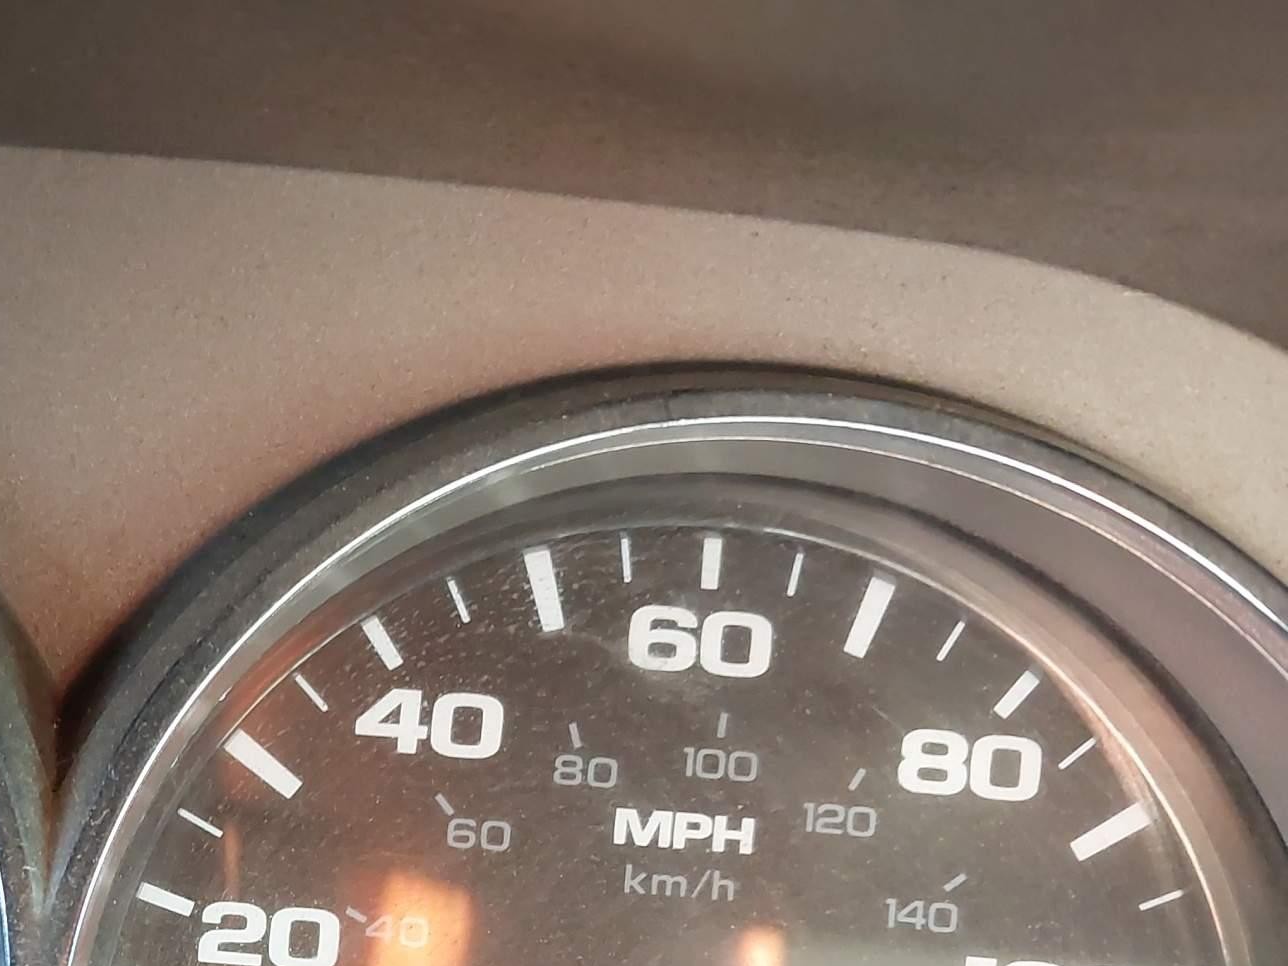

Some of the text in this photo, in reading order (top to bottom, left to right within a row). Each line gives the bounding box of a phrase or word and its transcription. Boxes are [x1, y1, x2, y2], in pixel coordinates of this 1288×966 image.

[627, 605, 773, 678] 60
[355, 689, 504, 760] 40
[553, 755, 618, 789] 80
[684, 746, 758, 783] 100
[897, 729, 1043, 803] 80
[447, 819, 512, 853] 60
[613, 808, 756, 855] MPH
[804, 802, 876, 839] 120
[623, 864, 736, 904] km/h
[364, 915, 428, 948] 40
[885, 898, 959, 934] 140
